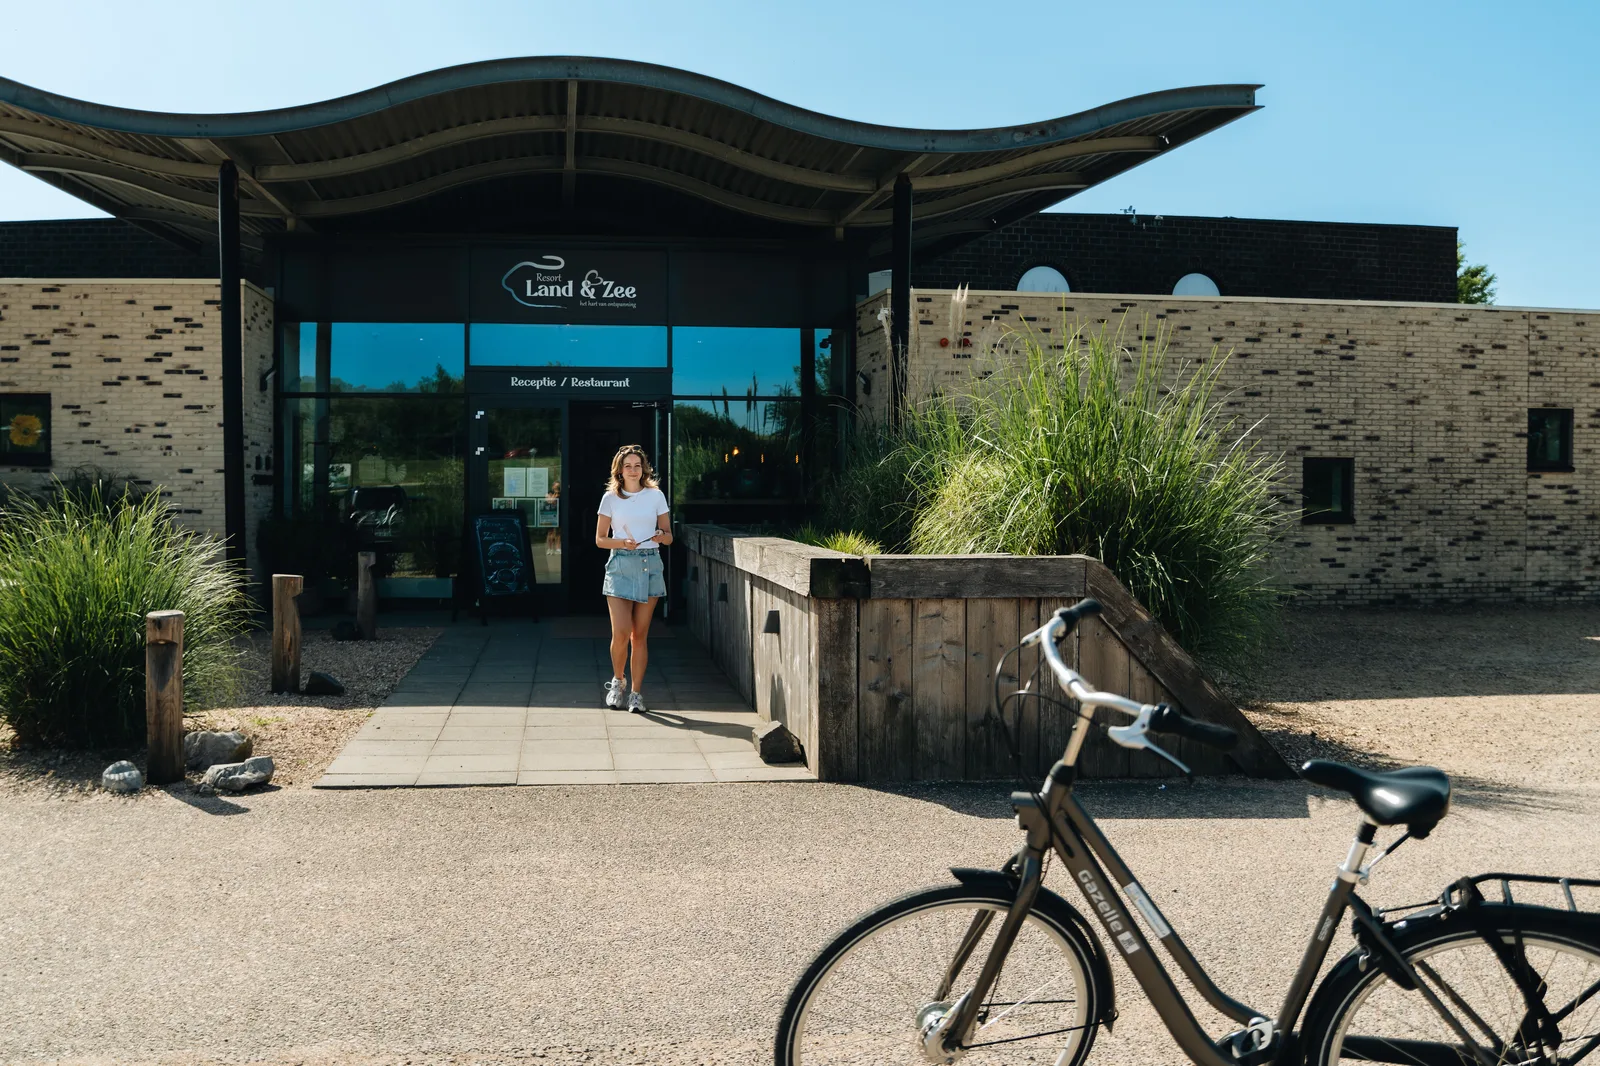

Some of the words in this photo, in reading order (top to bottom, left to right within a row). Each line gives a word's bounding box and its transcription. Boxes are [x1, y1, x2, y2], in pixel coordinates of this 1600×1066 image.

[536, 272, 562, 282] Resort
[526, 279, 574, 297] Land
[580, 276, 599, 299] &
[602, 280, 637, 299] Zee
[607, 301, 637, 309] ontspanning
[511, 376, 557, 390] Receptie
[560, 377, 567, 387] /
[571, 377, 631, 388] Restaurant
[1078, 869, 1123, 933] Gazelle
